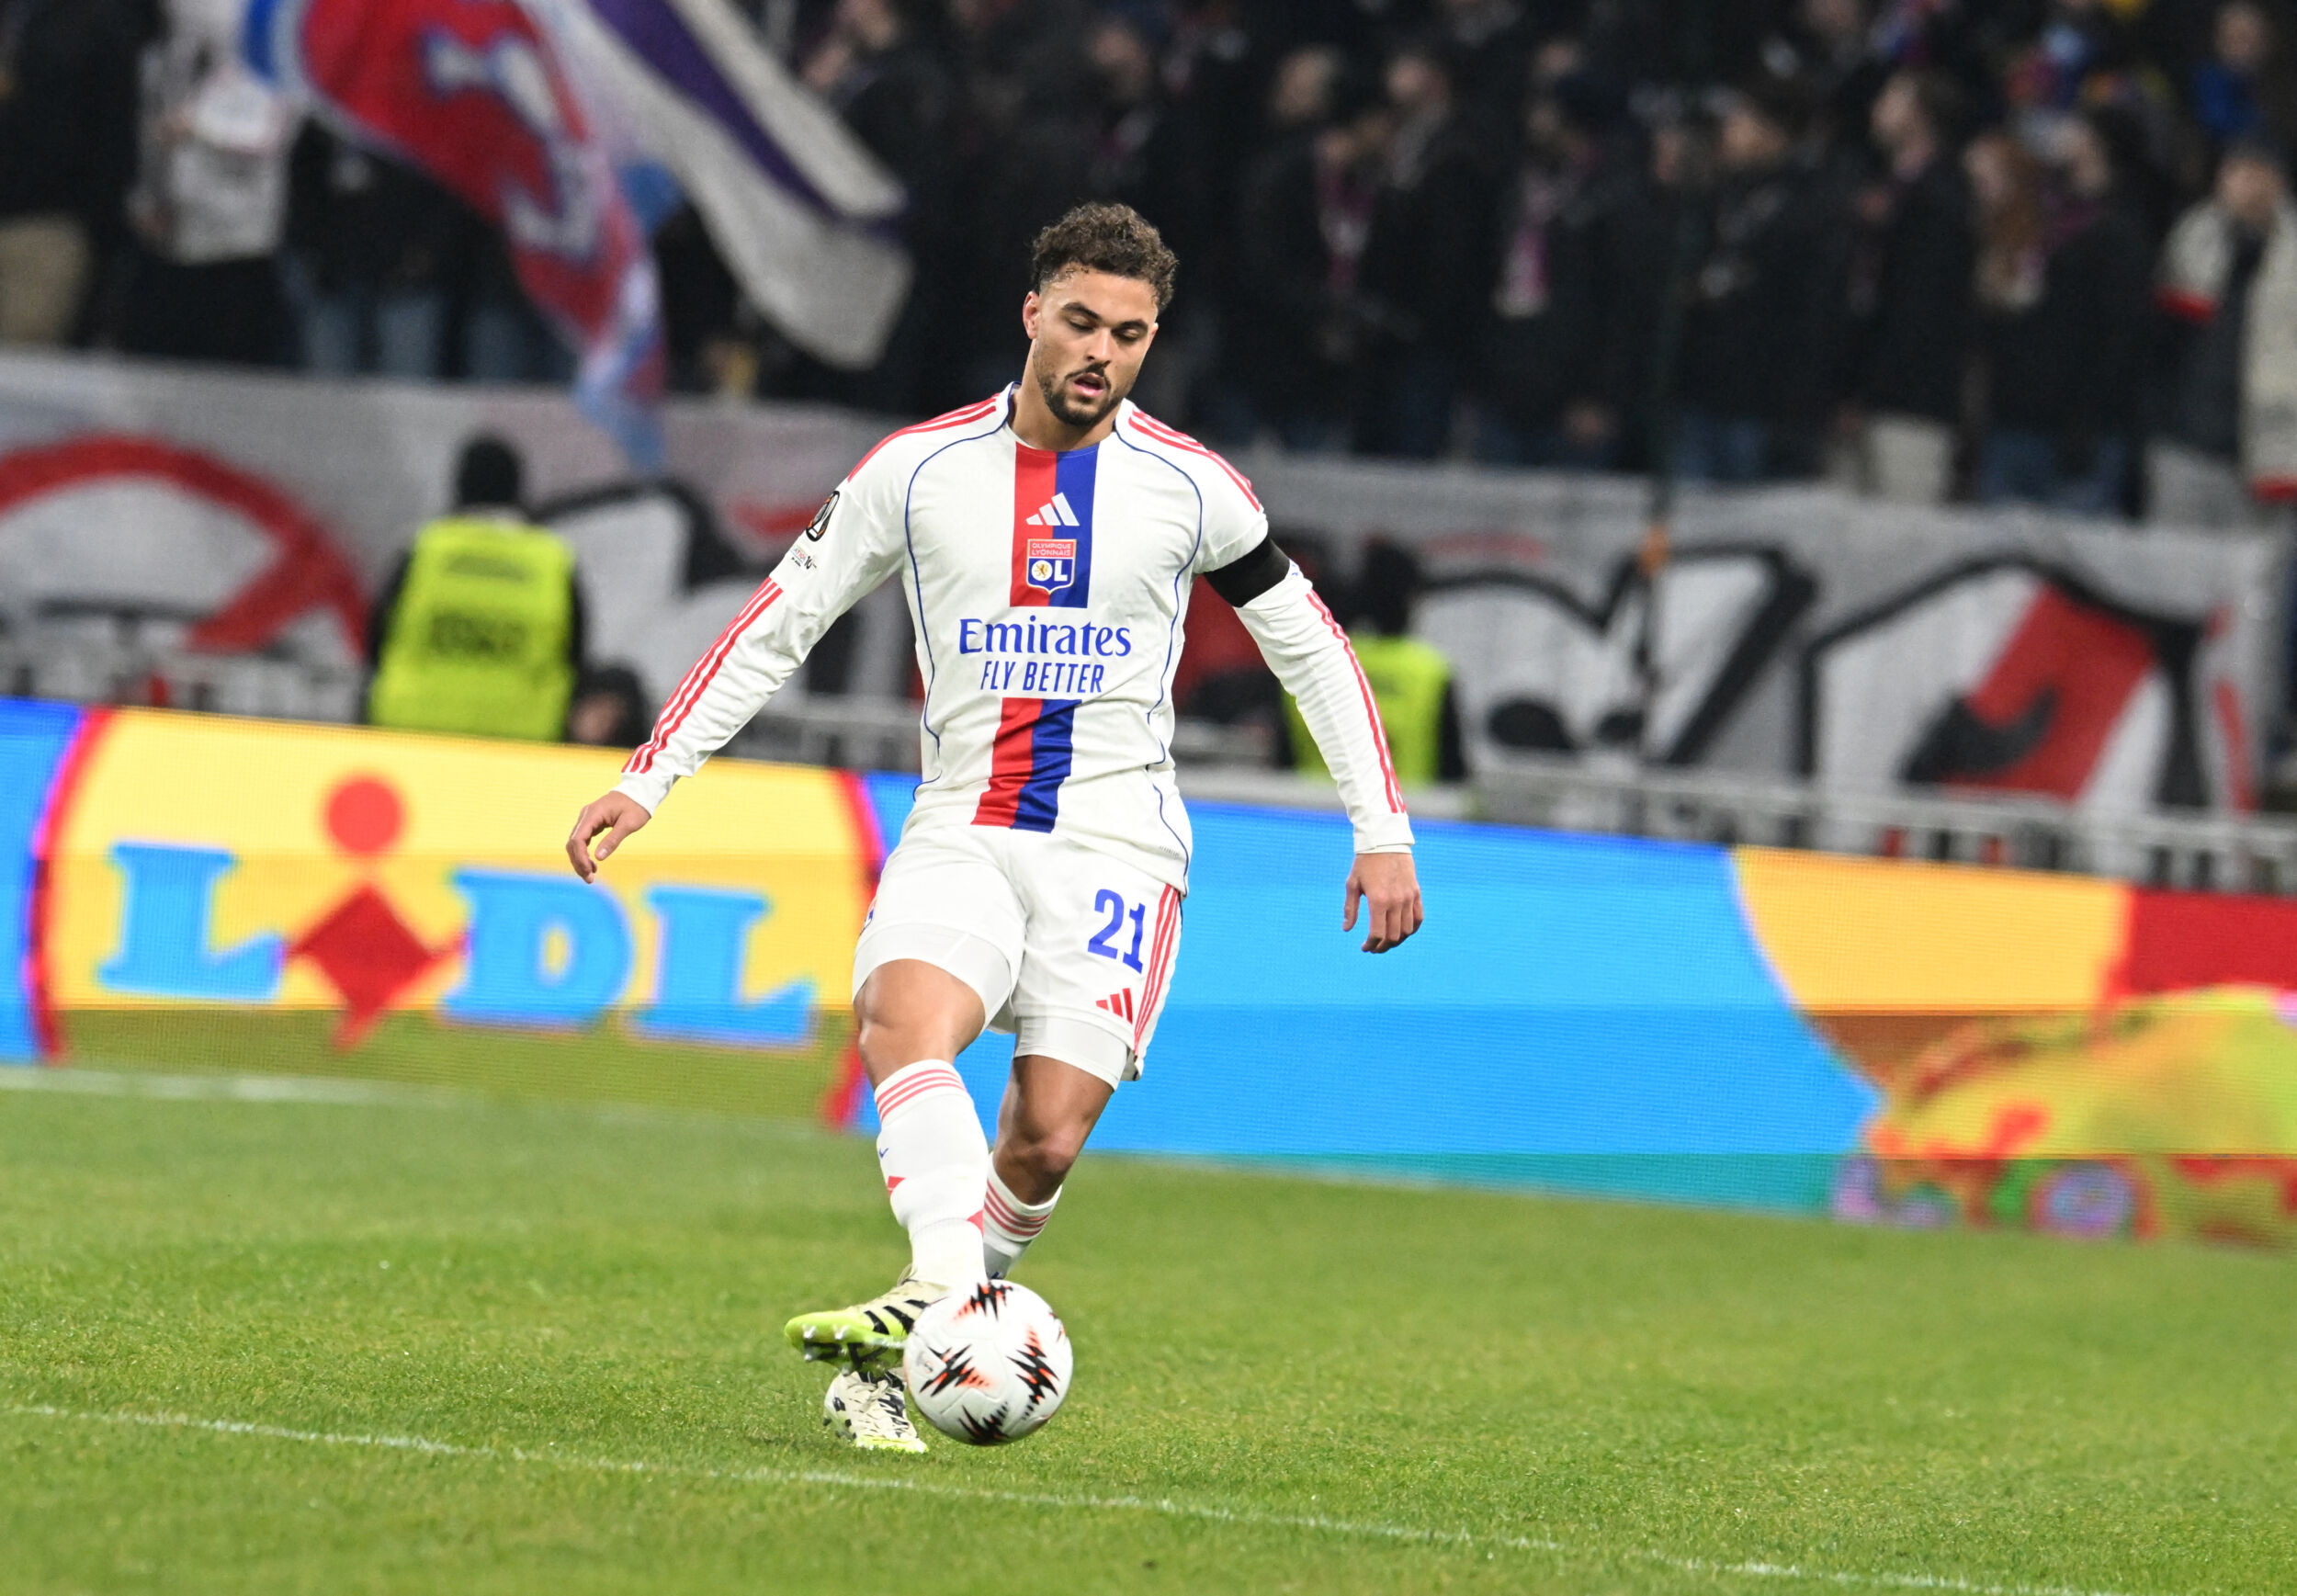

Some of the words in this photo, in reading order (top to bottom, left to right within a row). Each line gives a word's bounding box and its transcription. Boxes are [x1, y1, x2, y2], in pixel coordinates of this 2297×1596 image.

[1031, 560, 1069, 582] OL
[958, 614, 1132, 658] Emirates
[979, 660, 1016, 691] FLY
[1023, 661, 1105, 693] BETTER
[1087, 889, 1146, 975] 21
